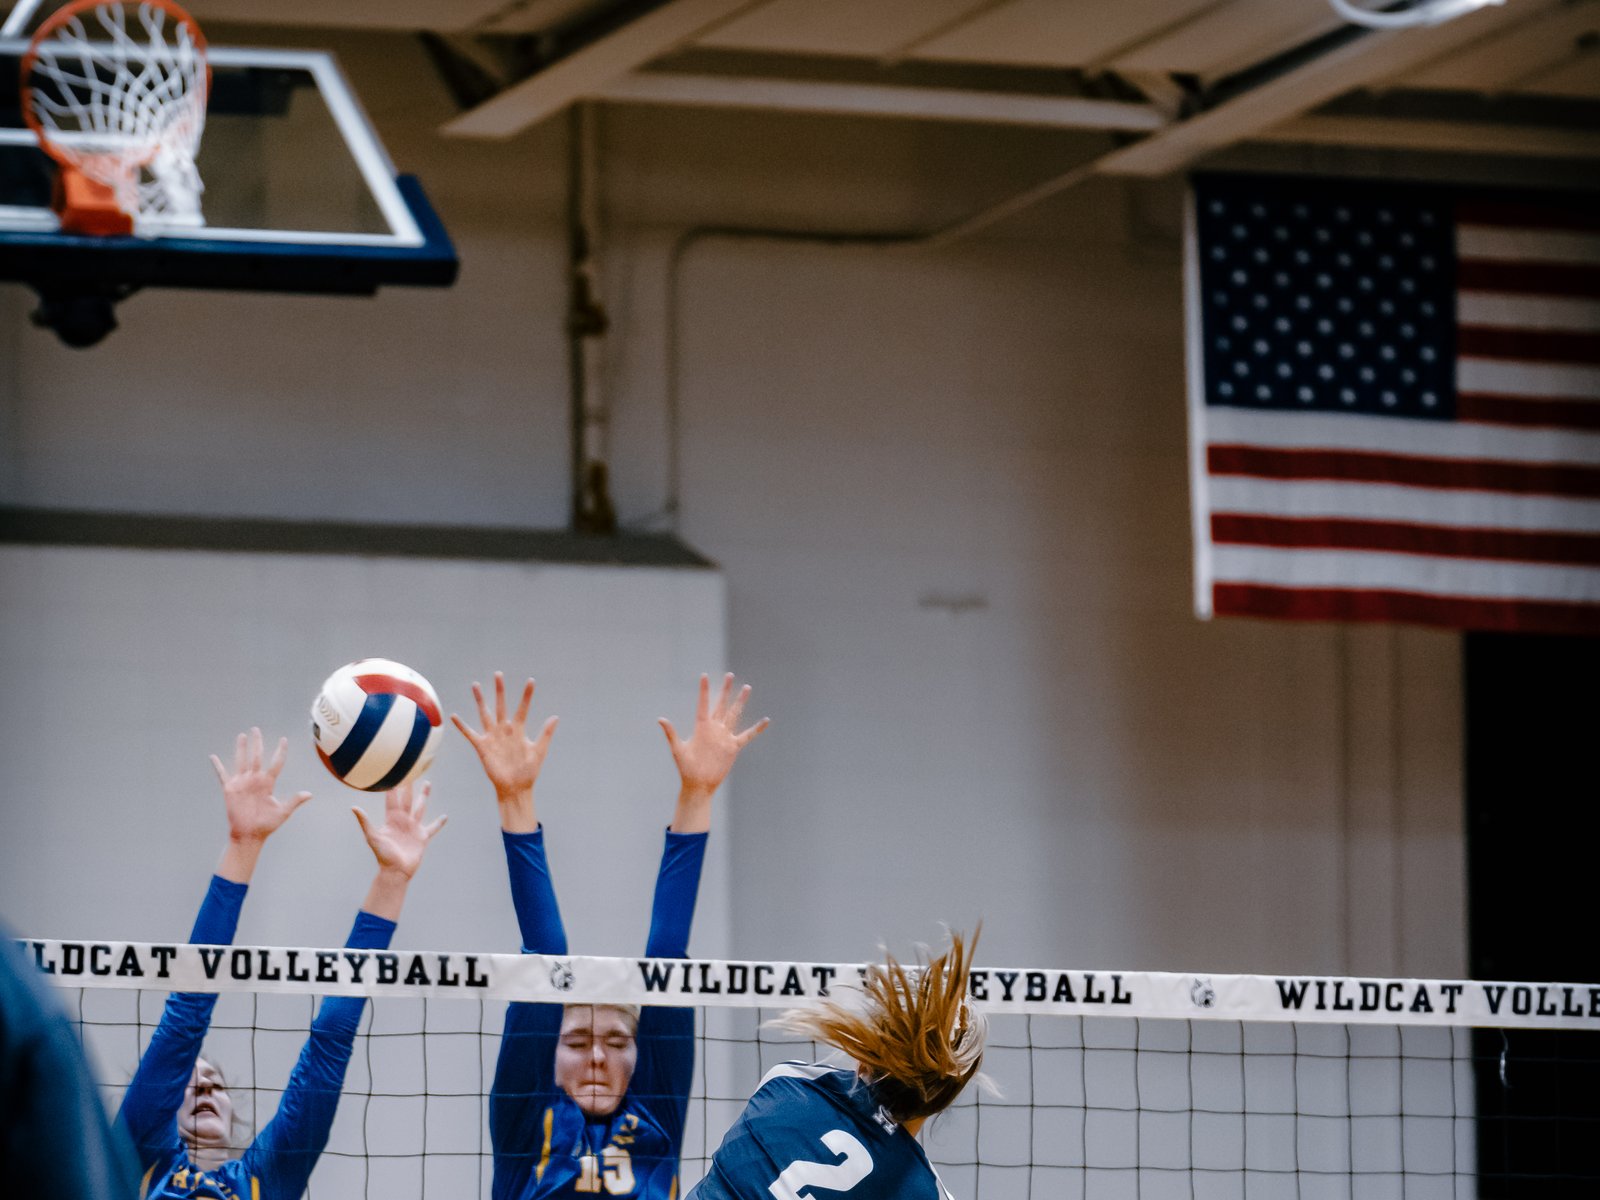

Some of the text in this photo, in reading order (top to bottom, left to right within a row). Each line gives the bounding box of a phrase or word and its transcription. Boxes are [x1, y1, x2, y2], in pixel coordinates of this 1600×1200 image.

[199, 948, 489, 988] VOLLEYBALL
[638, 961, 836, 996] WILDCAT
[858, 968, 1132, 1005] EYBALL
[1276, 979, 1463, 1014] WILDCAT
